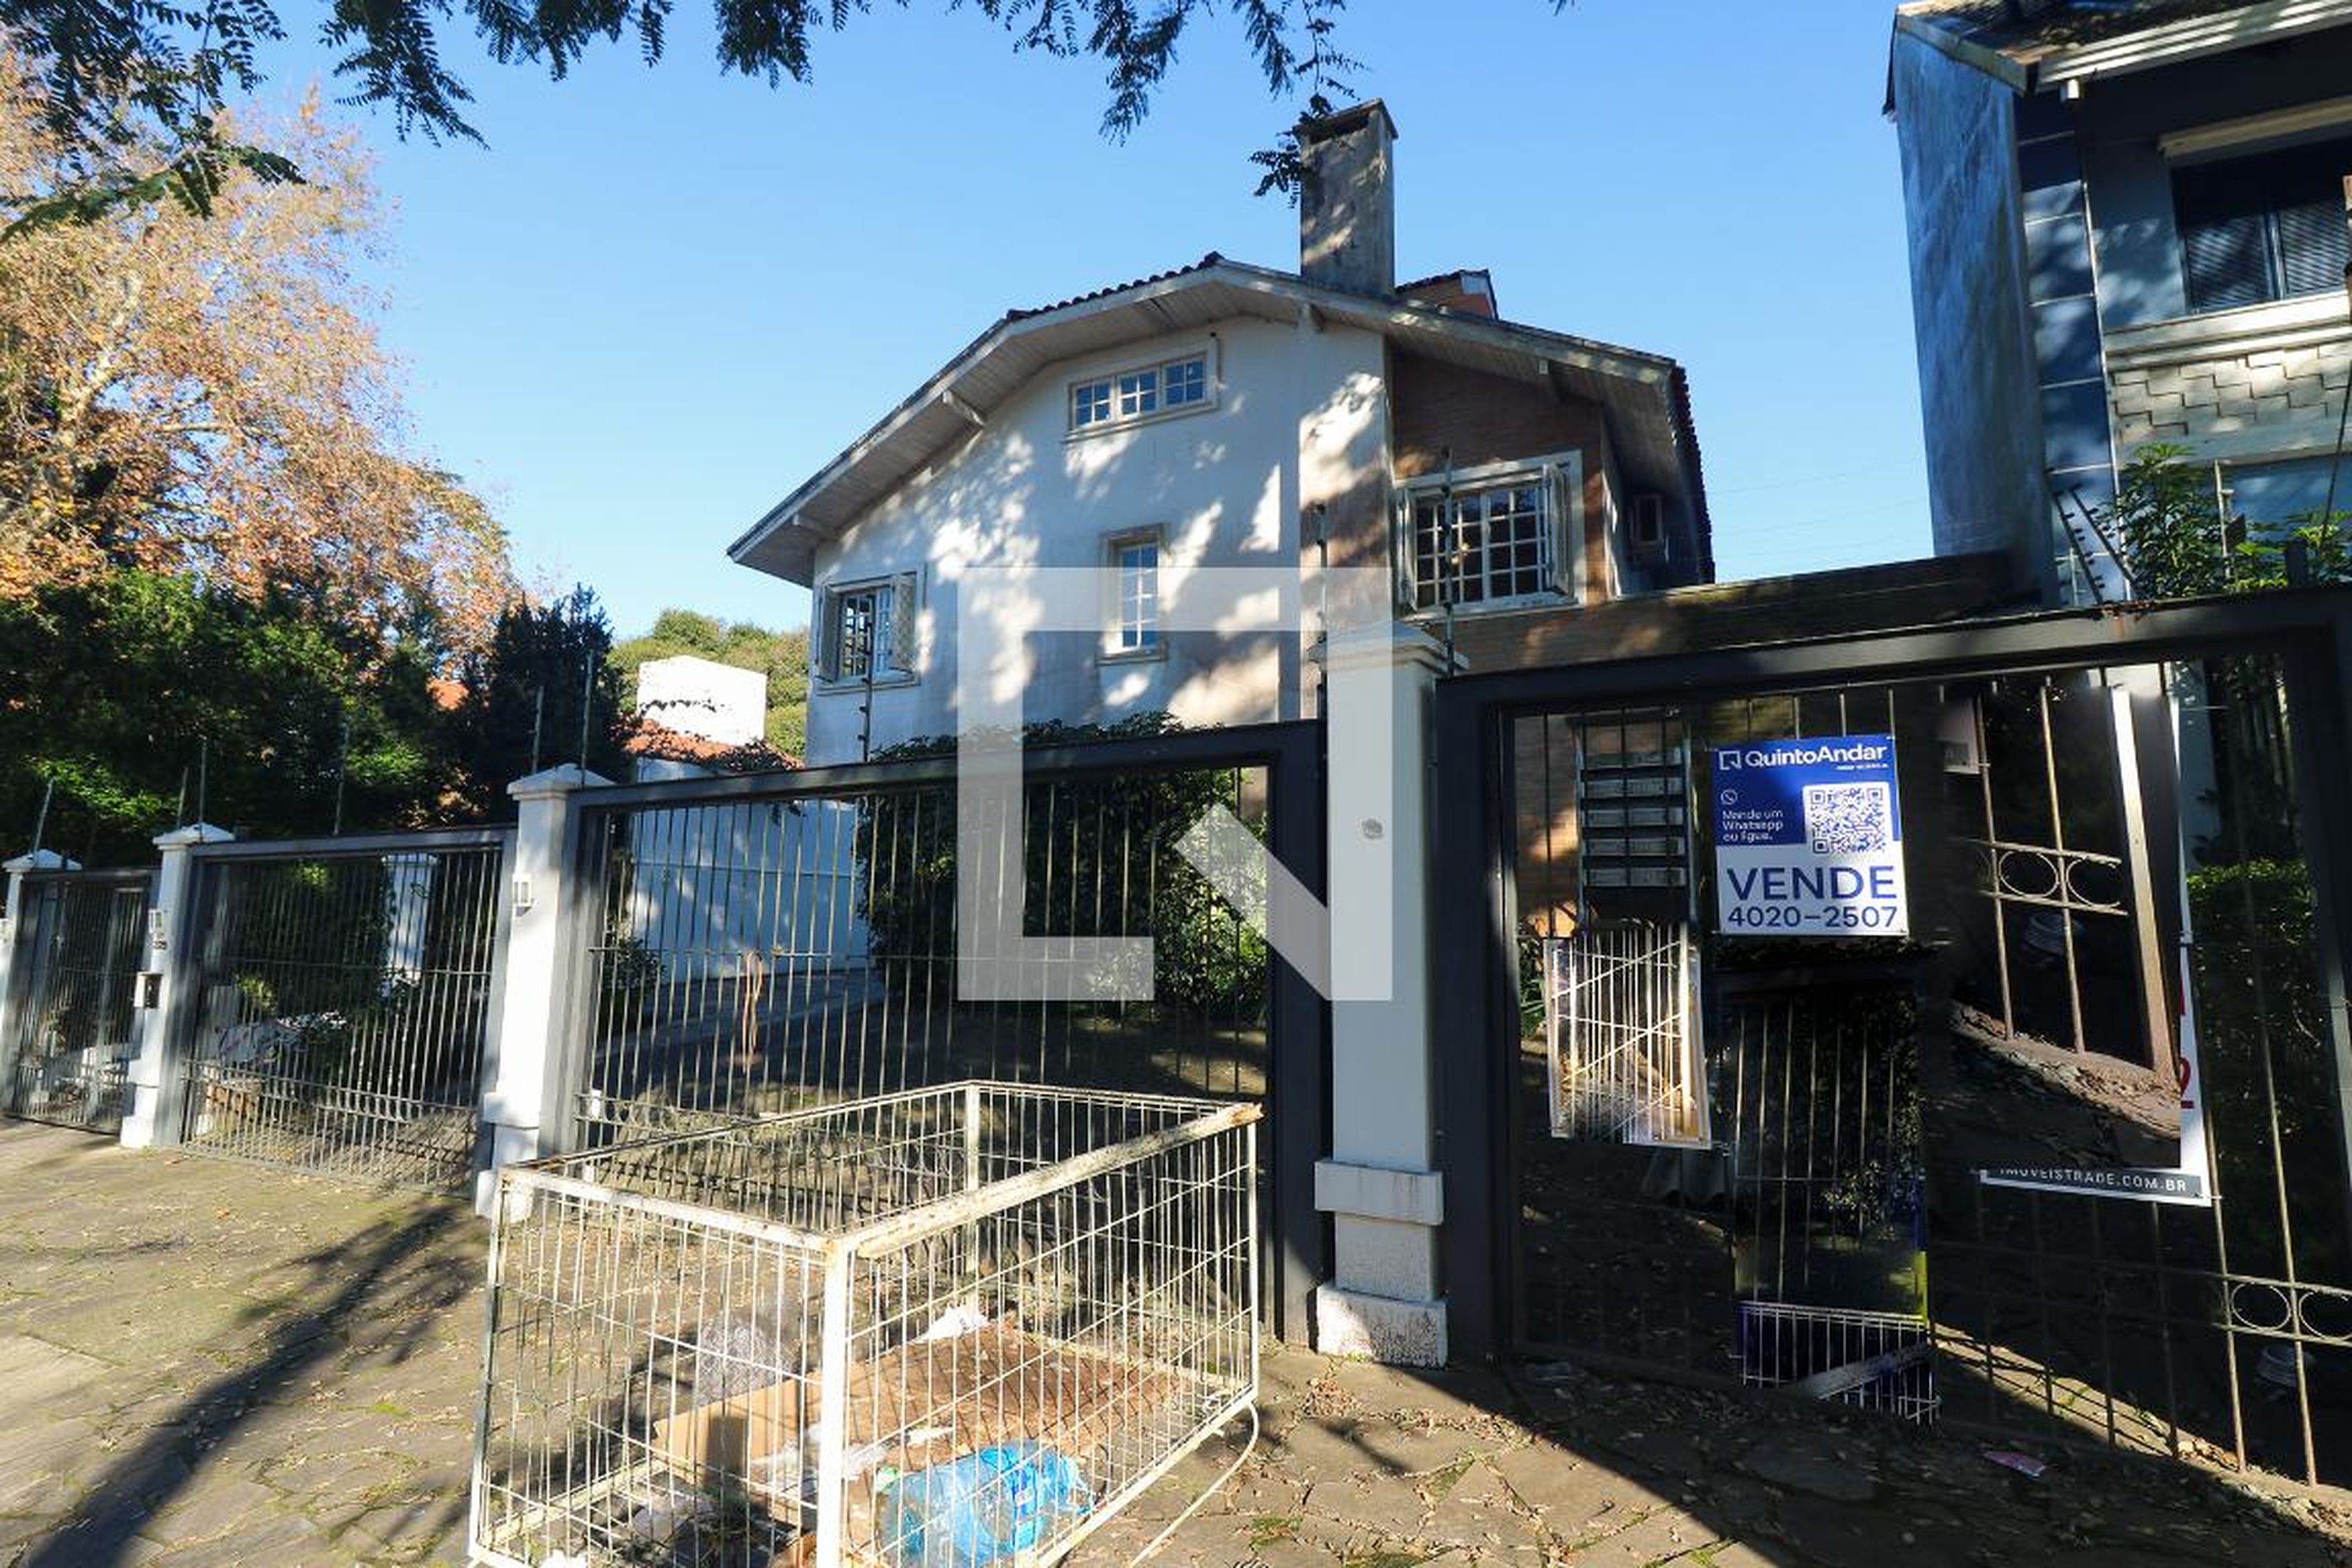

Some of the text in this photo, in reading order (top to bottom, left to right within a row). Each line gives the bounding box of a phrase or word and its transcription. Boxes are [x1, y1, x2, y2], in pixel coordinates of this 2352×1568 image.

[1745, 744, 1887, 767] QuintoAndar
[1764, 810, 1783, 819] um
[1722, 833, 1738, 842] ou
[1727, 865, 1897, 900] VENDE
[1728, 906, 1898, 928] 4020-2507
